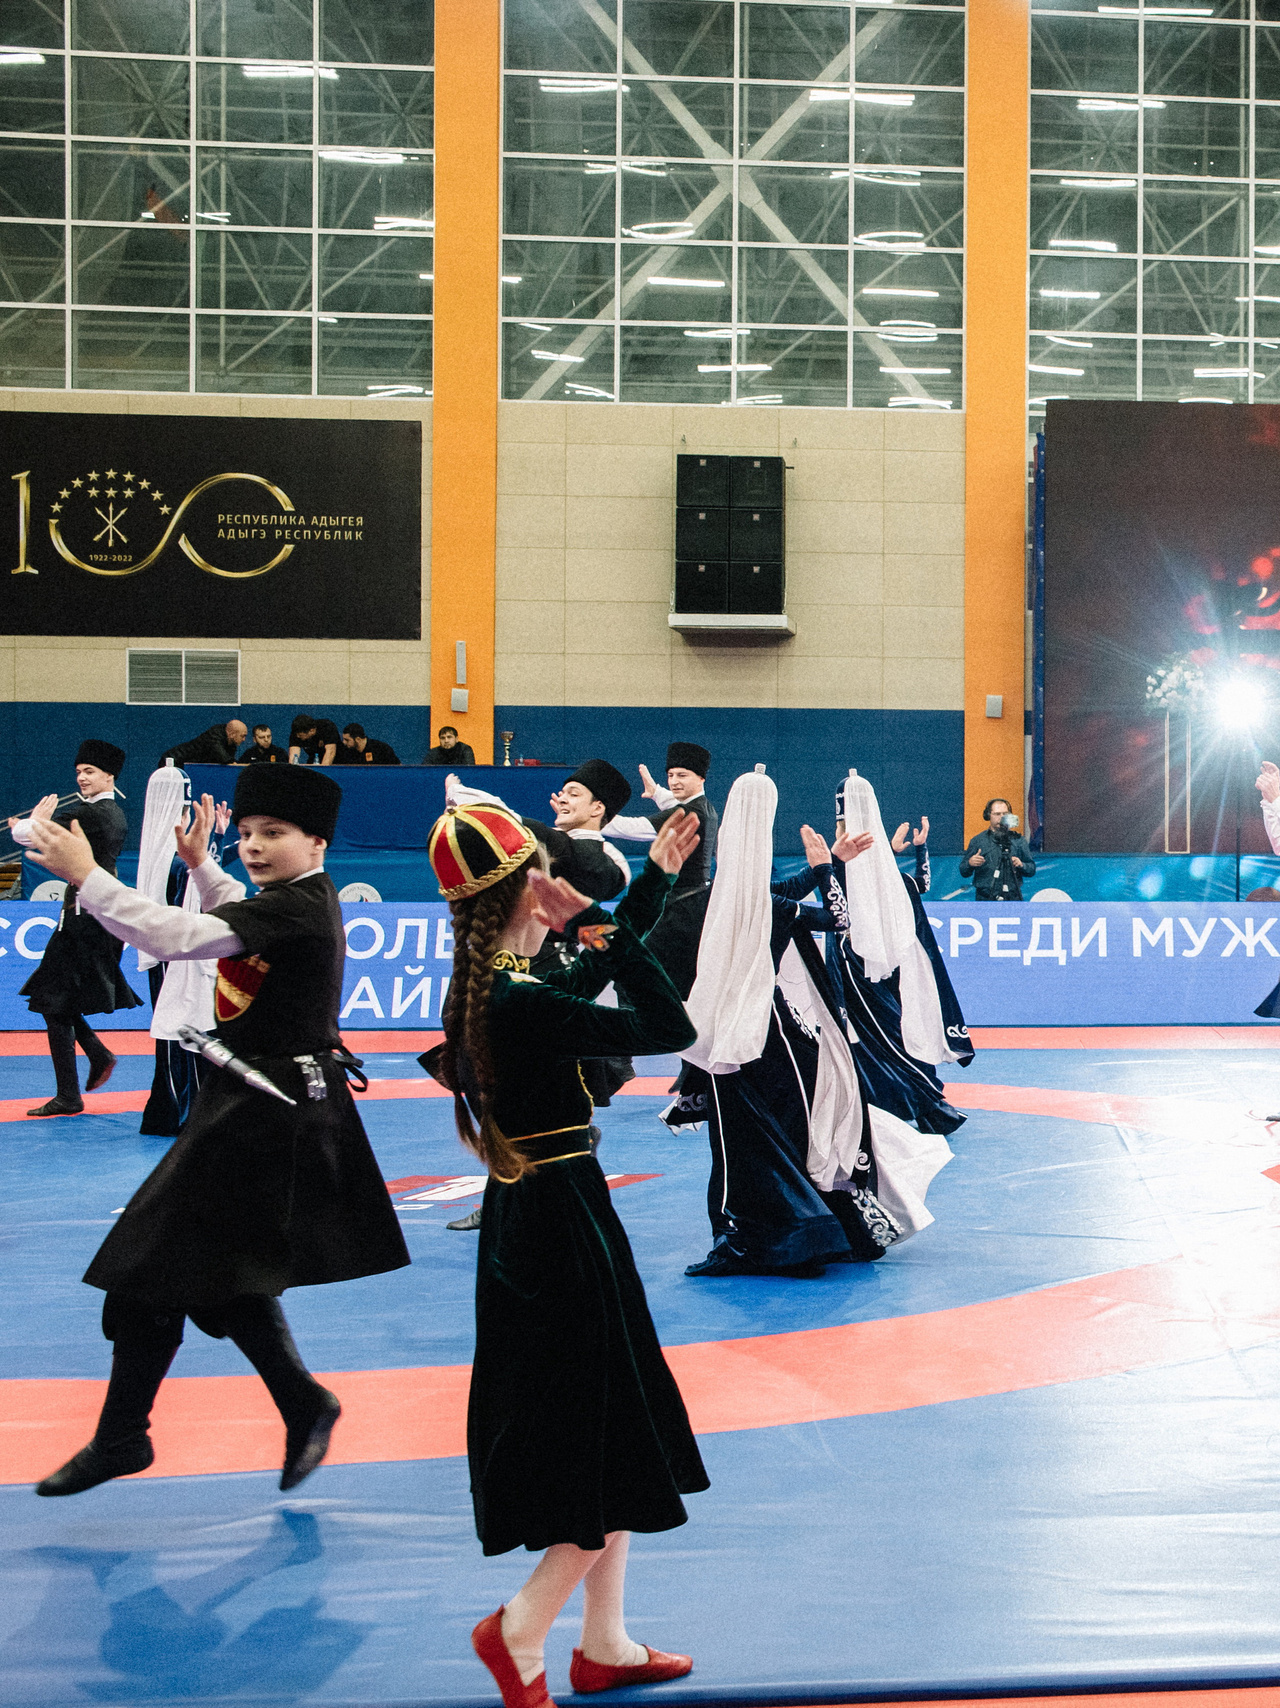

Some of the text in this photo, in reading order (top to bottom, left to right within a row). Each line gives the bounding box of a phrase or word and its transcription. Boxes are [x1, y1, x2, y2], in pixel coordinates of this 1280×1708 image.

[217, 513, 364, 528] РЕСПУБЛИКА АДЫГЕЯ
[217, 528, 364, 541] АДЫГЭ РЕСПУБЛИК
[89, 553, 133, 562] 1922-2022
